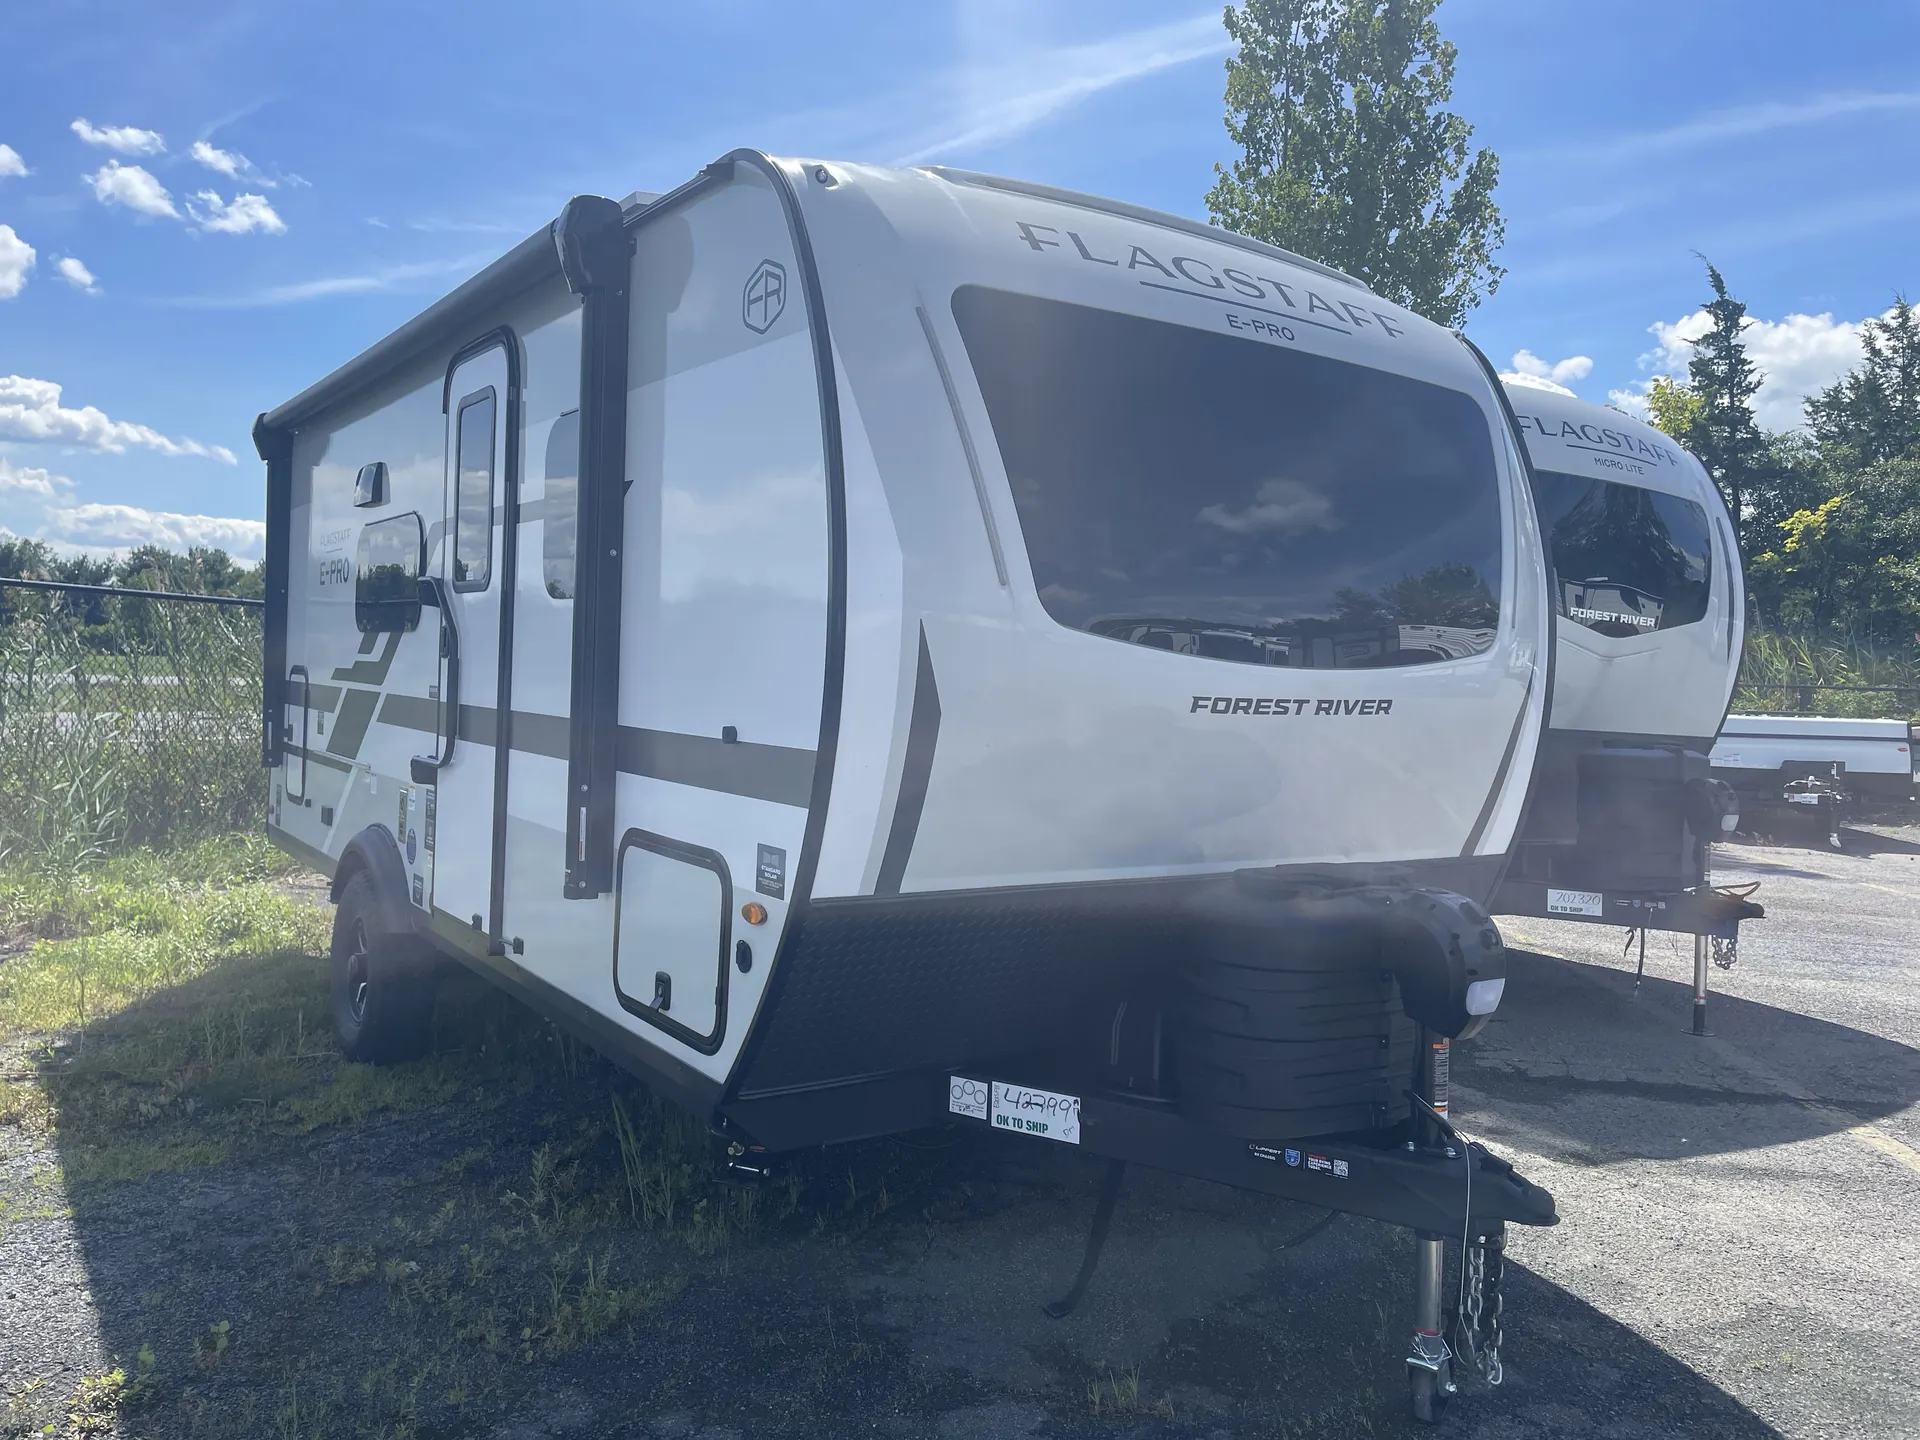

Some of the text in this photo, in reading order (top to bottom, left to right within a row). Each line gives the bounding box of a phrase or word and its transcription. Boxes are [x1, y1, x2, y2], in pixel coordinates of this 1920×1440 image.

[1016, 221, 1404, 339] FLAGSTAFF
[1226, 313, 1295, 342] E-PRO
[1515, 415, 1679, 467] FLAGSTAFF
[1594, 456, 1645, 475] MICRO LITE
[320, 557, 350, 585] E-PRO
[1570, 607, 1656, 628] FOREST RIVER
[1190, 695, 1393, 715] FOREST RIVER
[996, 1114, 1049, 1134] OK TO SHIP
